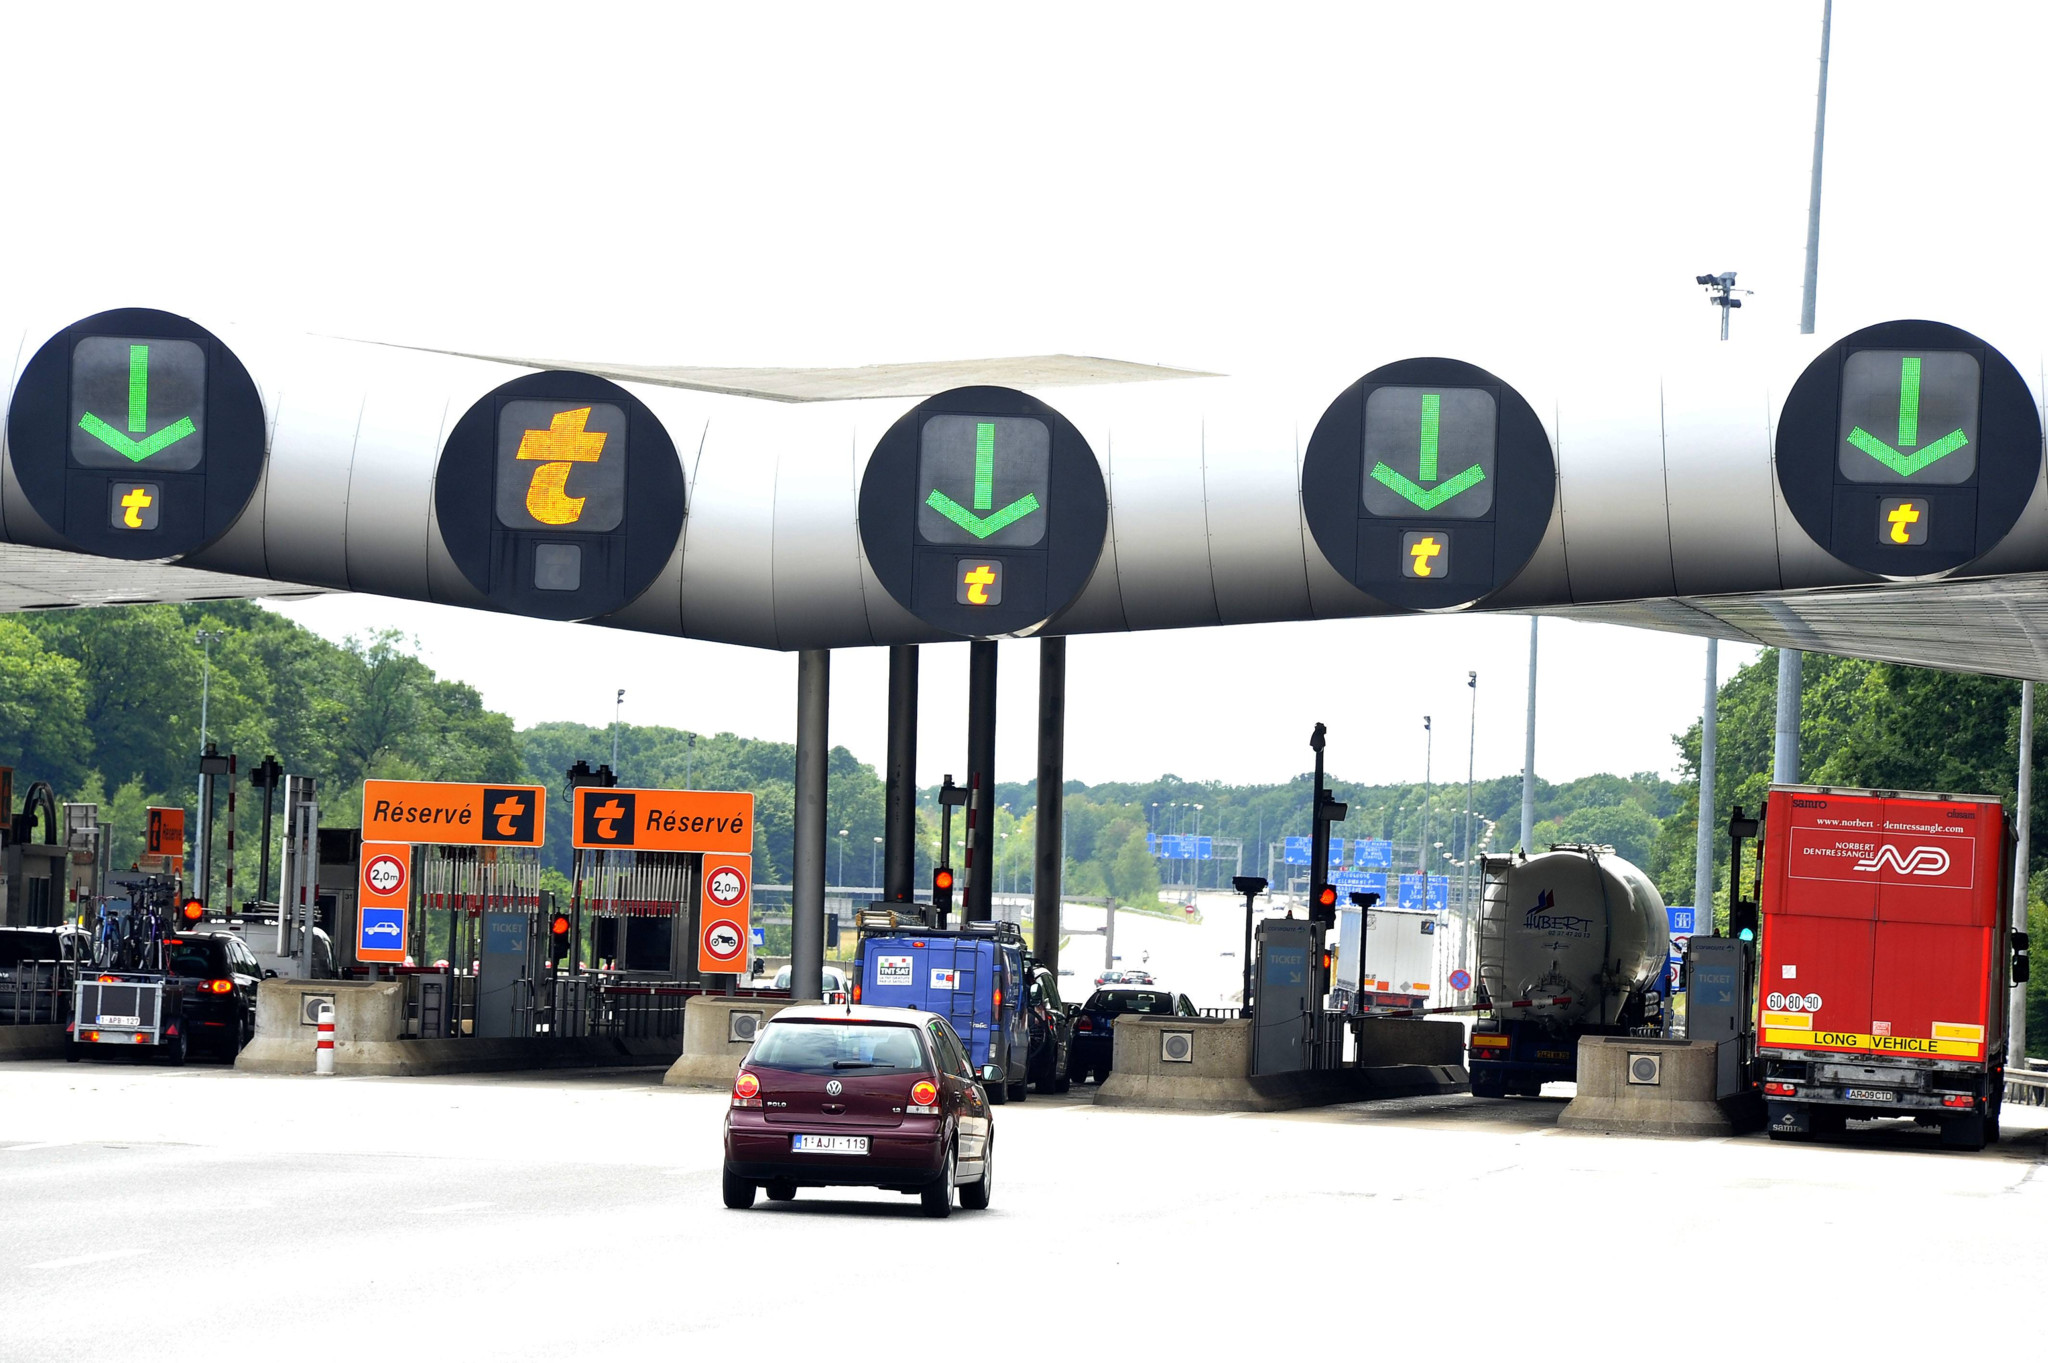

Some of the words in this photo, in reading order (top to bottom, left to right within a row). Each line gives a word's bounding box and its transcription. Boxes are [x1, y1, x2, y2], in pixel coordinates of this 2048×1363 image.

[1792, 799, 1828, 810] samro
[373, 800, 472, 825] Réservé
[646, 809, 743, 834] Réservé
[1816, 817, 1874, 829] www.norbert
[1835, 841, 1875, 851] NORBERT
[1803, 848, 1875, 859] DENTRESSANGLE
[491, 922, 523, 933] TICKET
[1523, 914, 1593, 933] HUBERT
[1271, 954, 1303, 965] TICKET
[880, 967, 895, 975] TNT
[895, 967, 910, 975] SAT
[1699, 974, 1731, 984] TICKET
[1769, 994, 1782, 1009] 60
[1788, 995, 1801, 1010] 80
[1814, 1032, 1857, 1046] LONG
[1872, 1036, 1938, 1052] VEHICLE
